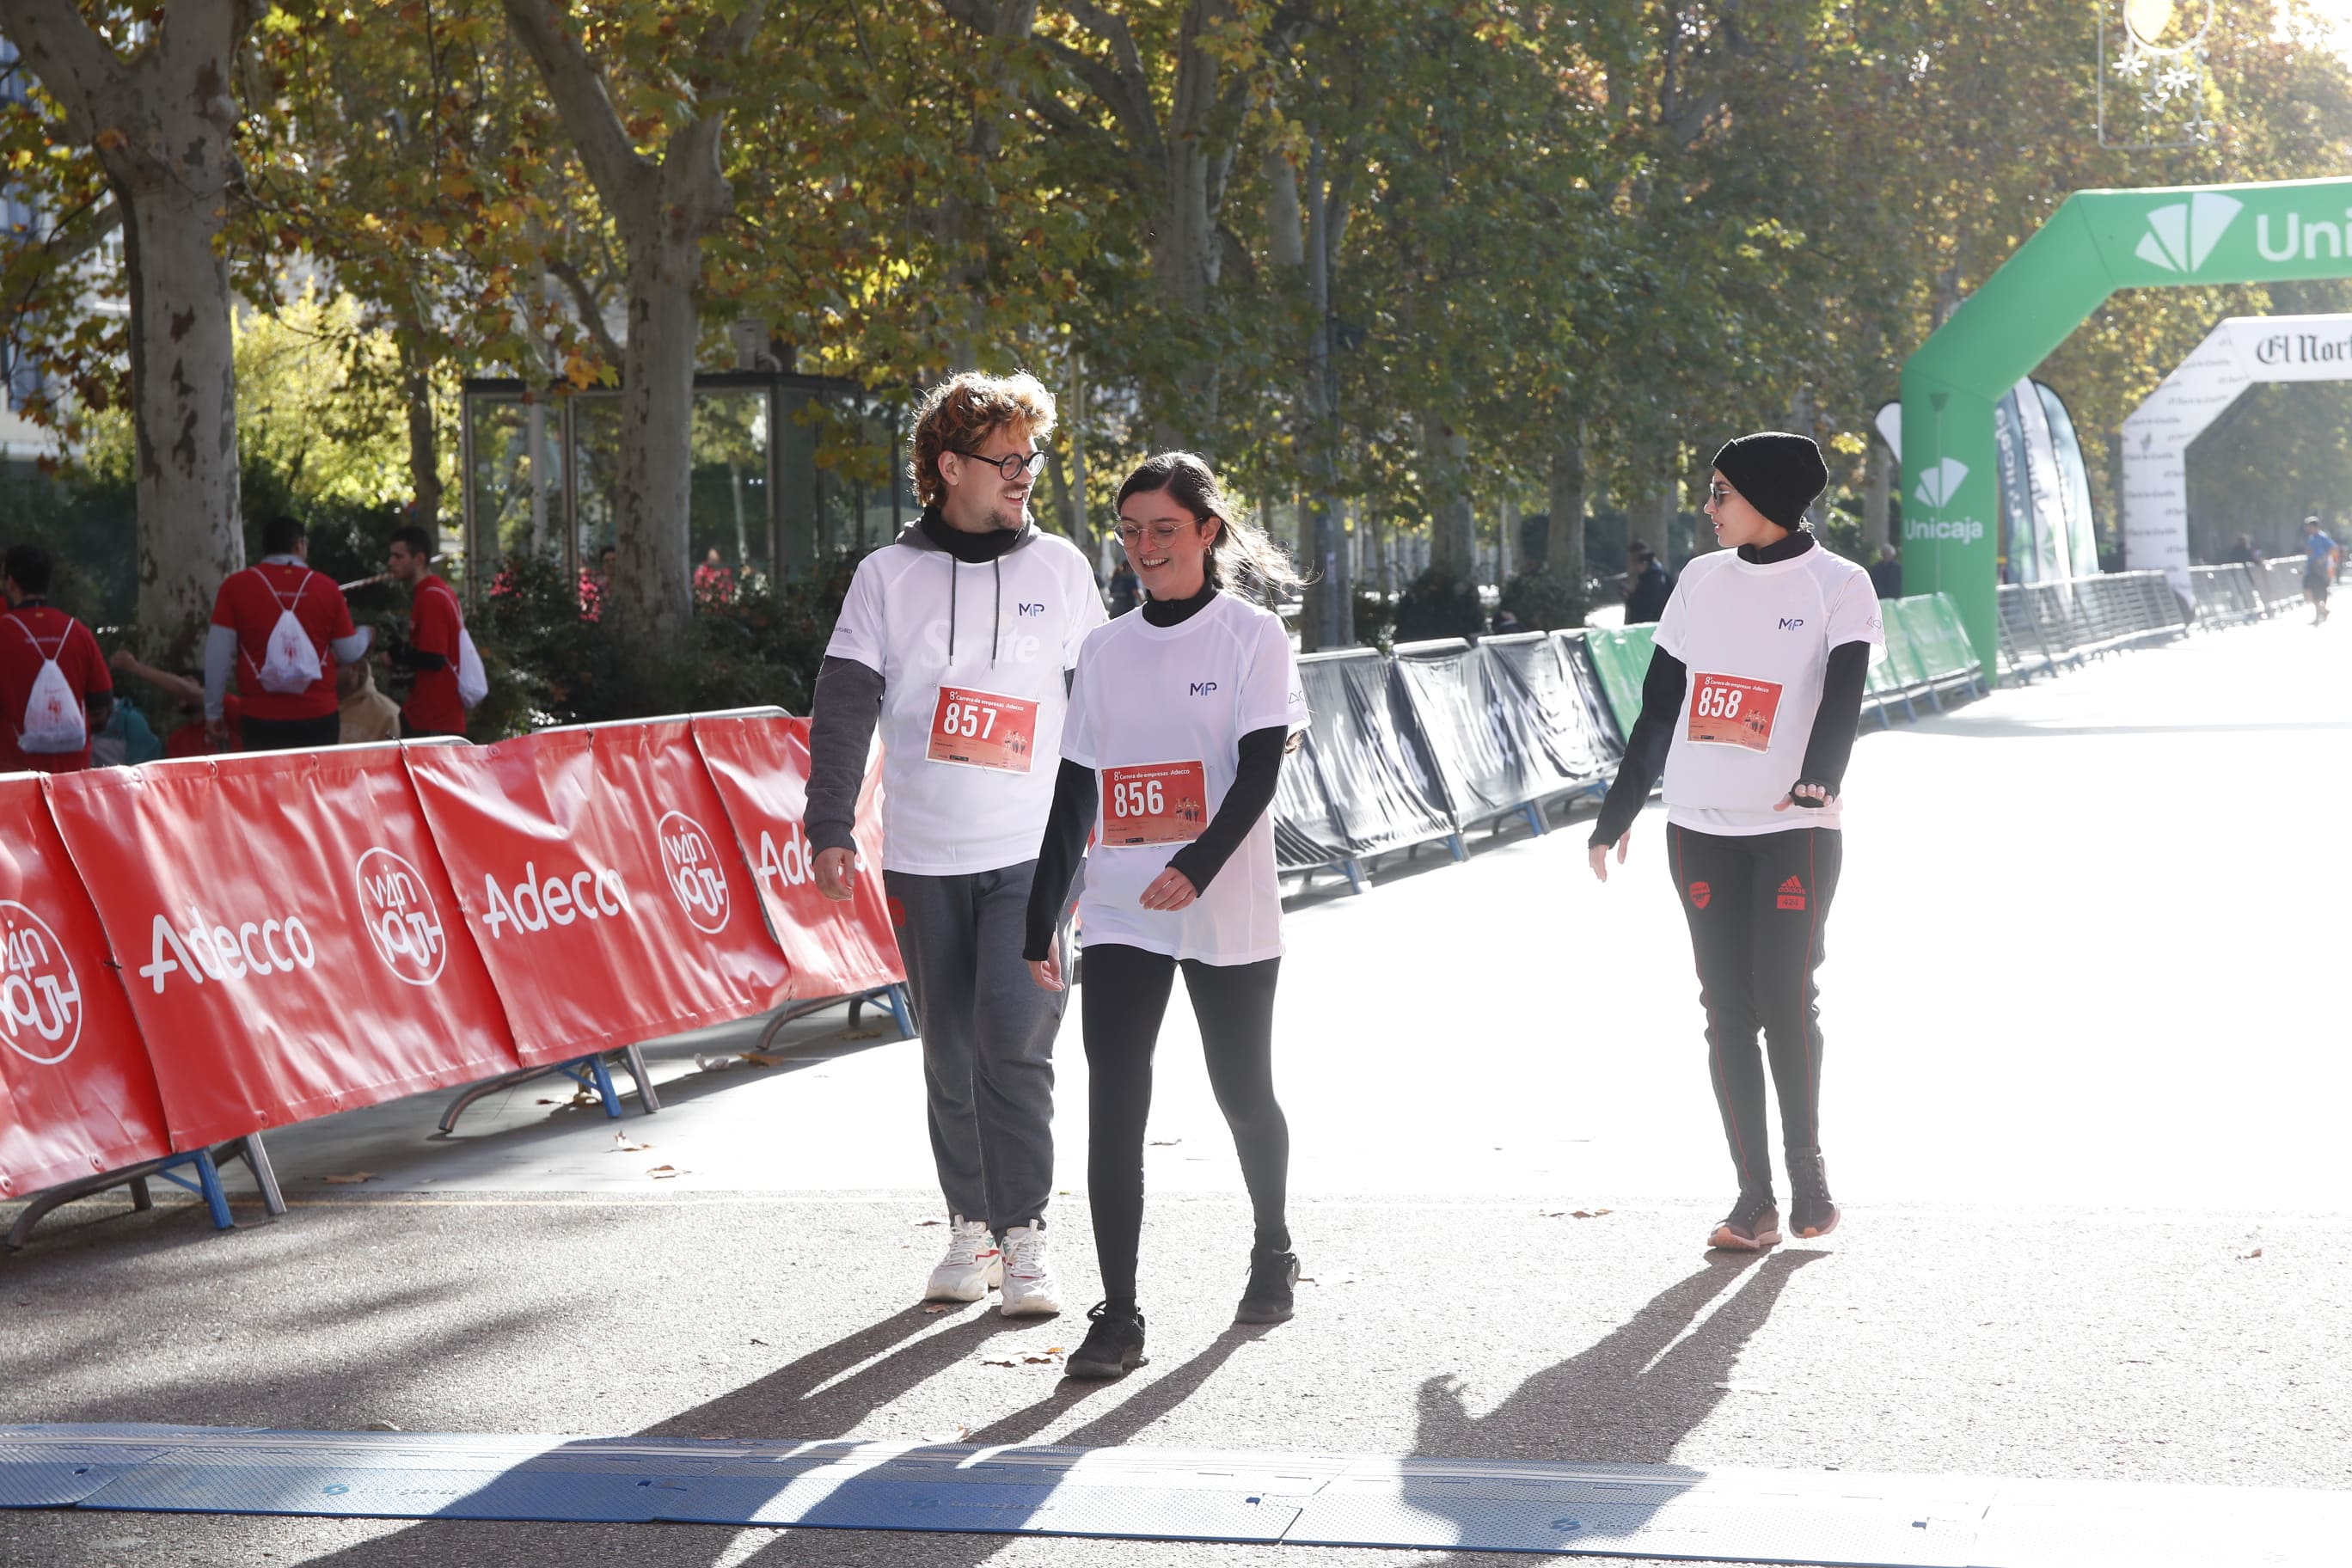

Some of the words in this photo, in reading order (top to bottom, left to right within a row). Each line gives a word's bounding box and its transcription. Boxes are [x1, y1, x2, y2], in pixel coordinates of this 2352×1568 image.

[2256, 334, 2291, 365] El
[2297, 333, 2352, 364] Nor
[1903, 516, 1984, 546] Unicaja
[1018, 603, 1045, 617] MP
[1778, 617, 1804, 632] MP
[1189, 682, 1217, 697] MP
[1698, 686, 1743, 719] 858
[943, 702, 997, 739] 857
[1113, 780, 1164, 818] 856
[481, 861, 632, 940] Adecco
[138, 905, 315, 995] Adecco
